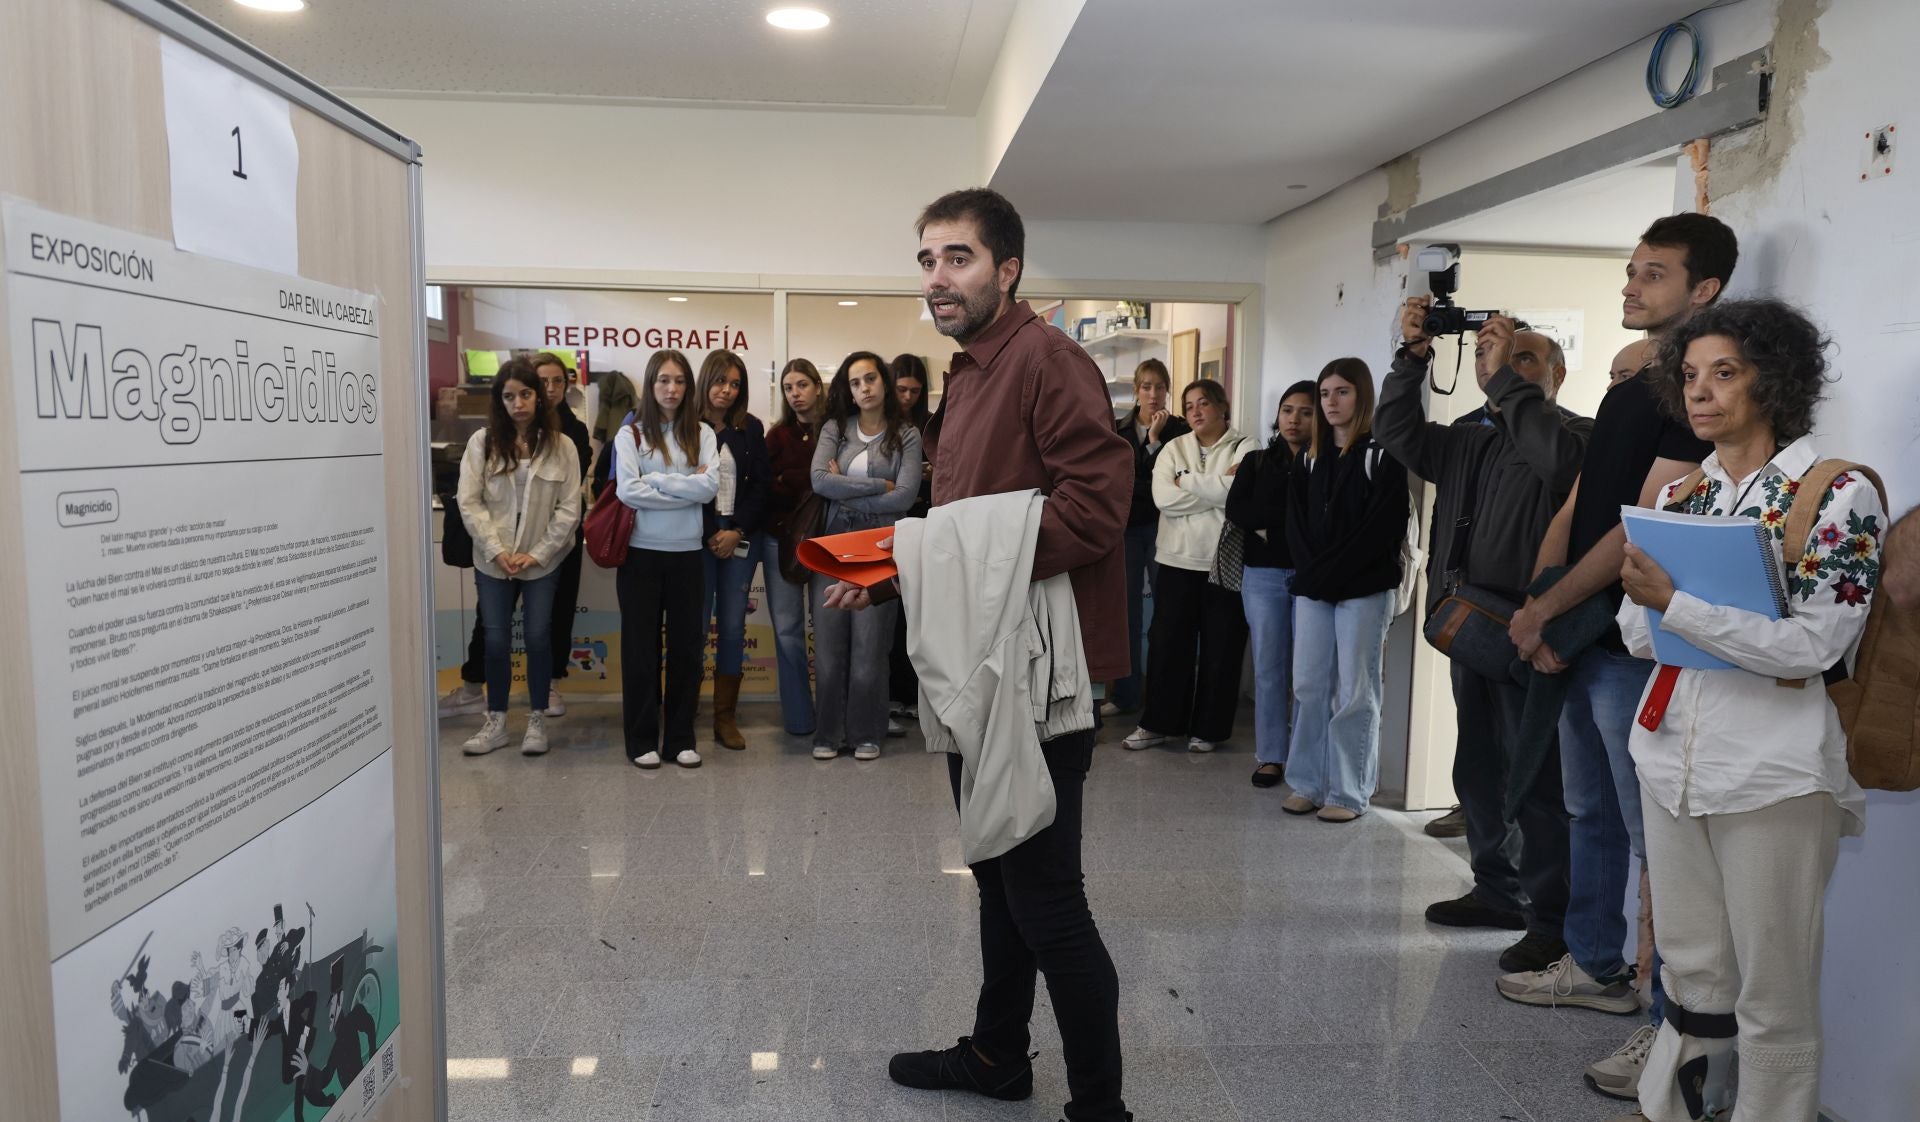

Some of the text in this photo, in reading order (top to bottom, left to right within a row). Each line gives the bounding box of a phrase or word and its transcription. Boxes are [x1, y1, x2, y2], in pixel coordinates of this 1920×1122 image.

[231, 126, 247, 180] 1
[31, 232, 153, 281] EXPOSICIÓN
[280, 290, 373, 325] DAR EN LA CABEZA
[544, 325, 749, 350] REPROGRAFÍA
[32, 318, 377, 444] Magnicidios
[66, 500, 112, 517] Magnicidio
